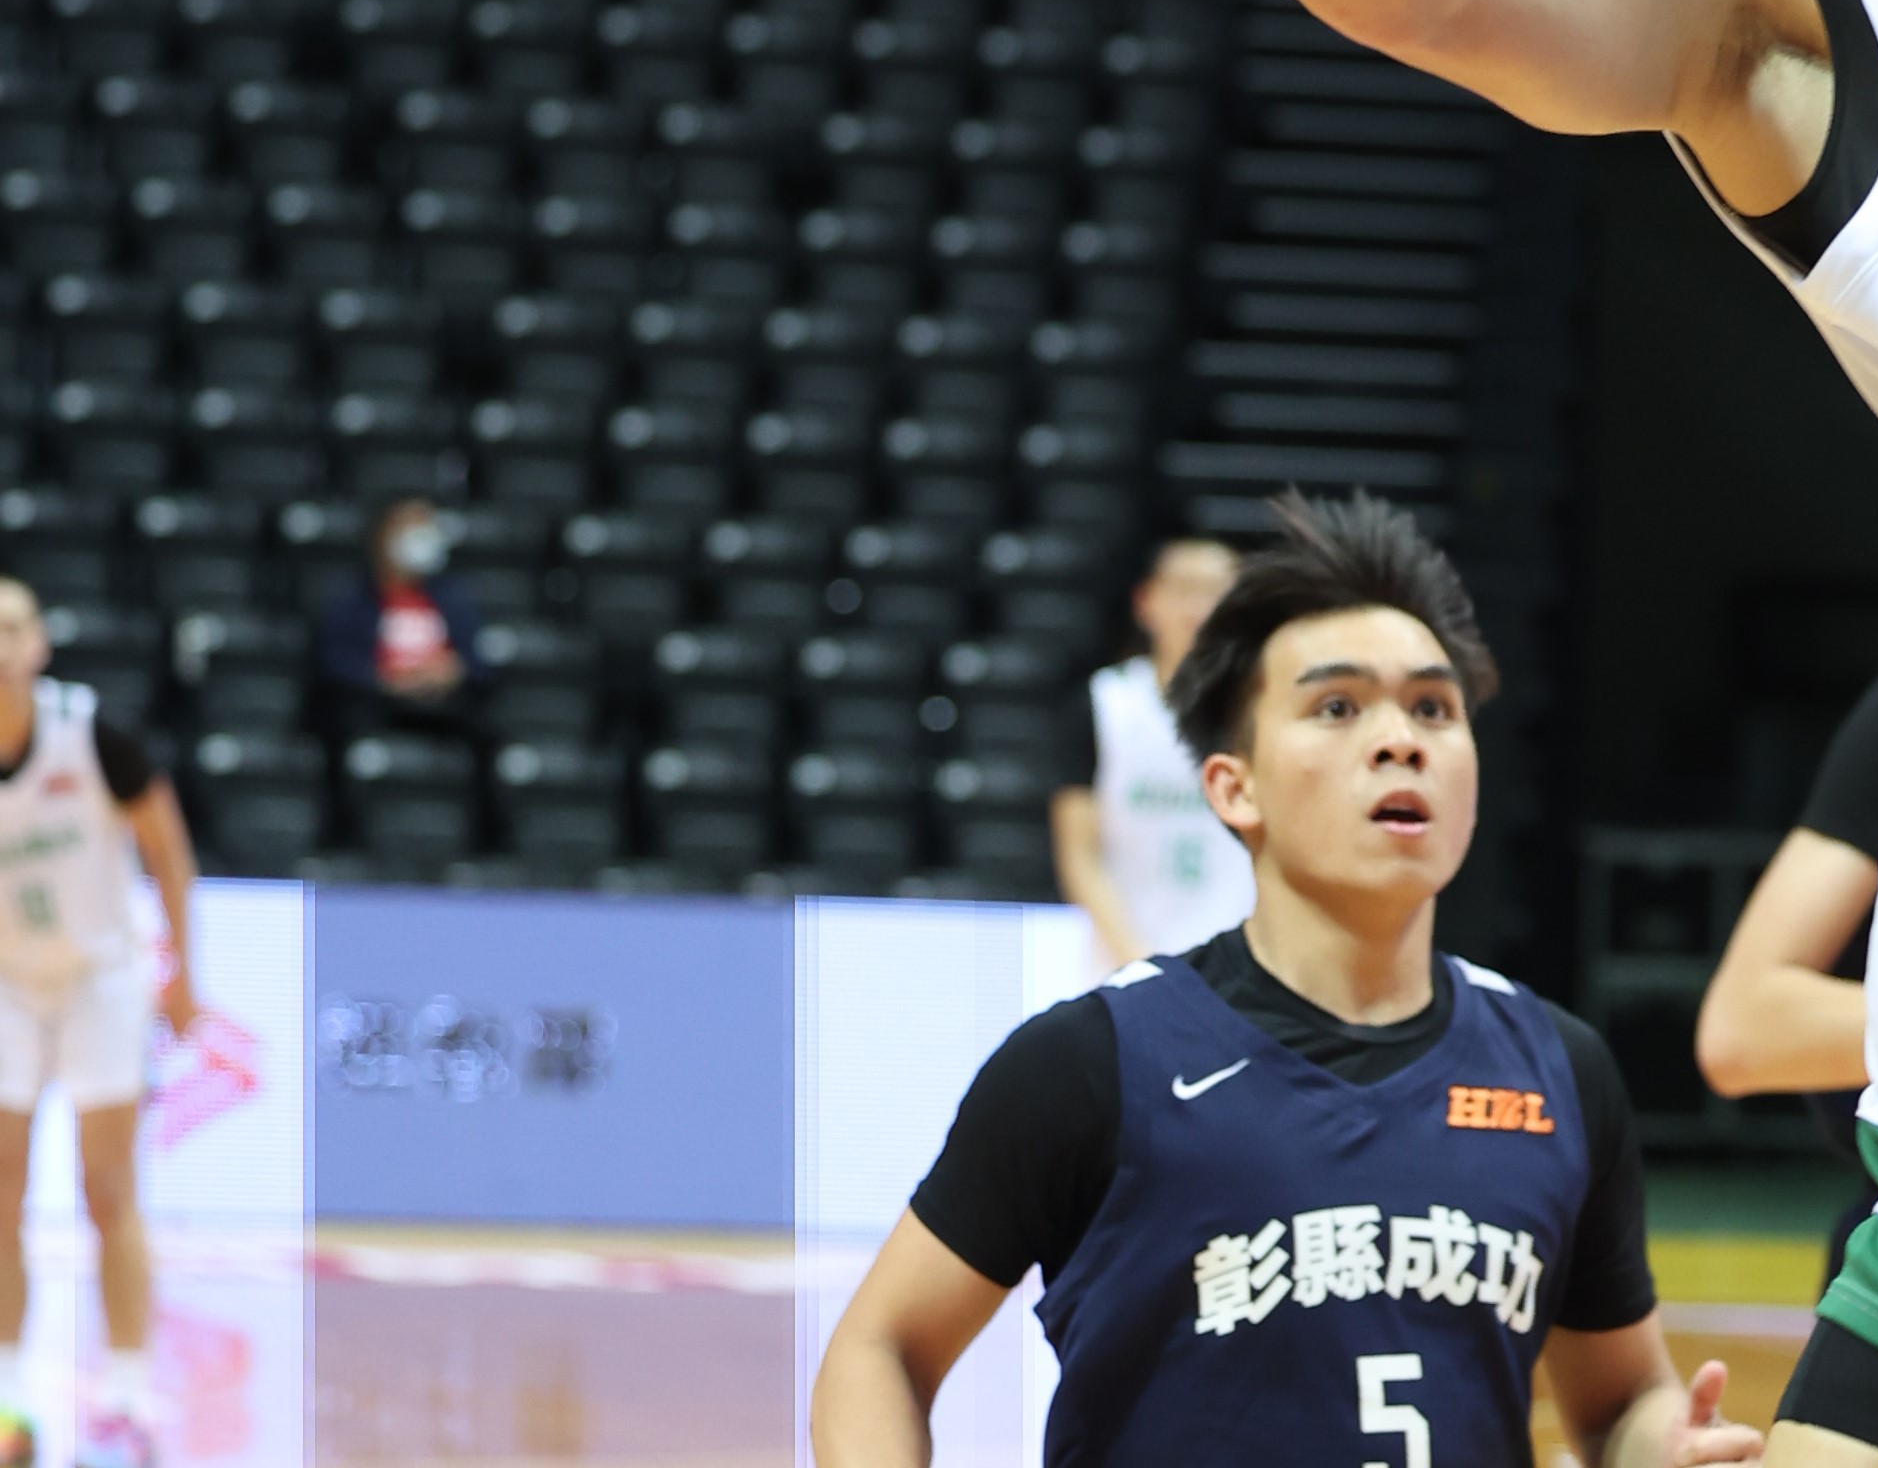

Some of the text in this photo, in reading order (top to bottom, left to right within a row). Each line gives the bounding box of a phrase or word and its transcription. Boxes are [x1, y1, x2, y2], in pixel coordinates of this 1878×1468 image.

[1446, 1084, 1556, 1135] HBL
[1193, 1203, 1545, 1337] 彰縣成功
[1355, 1352, 1432, 1468] 5
